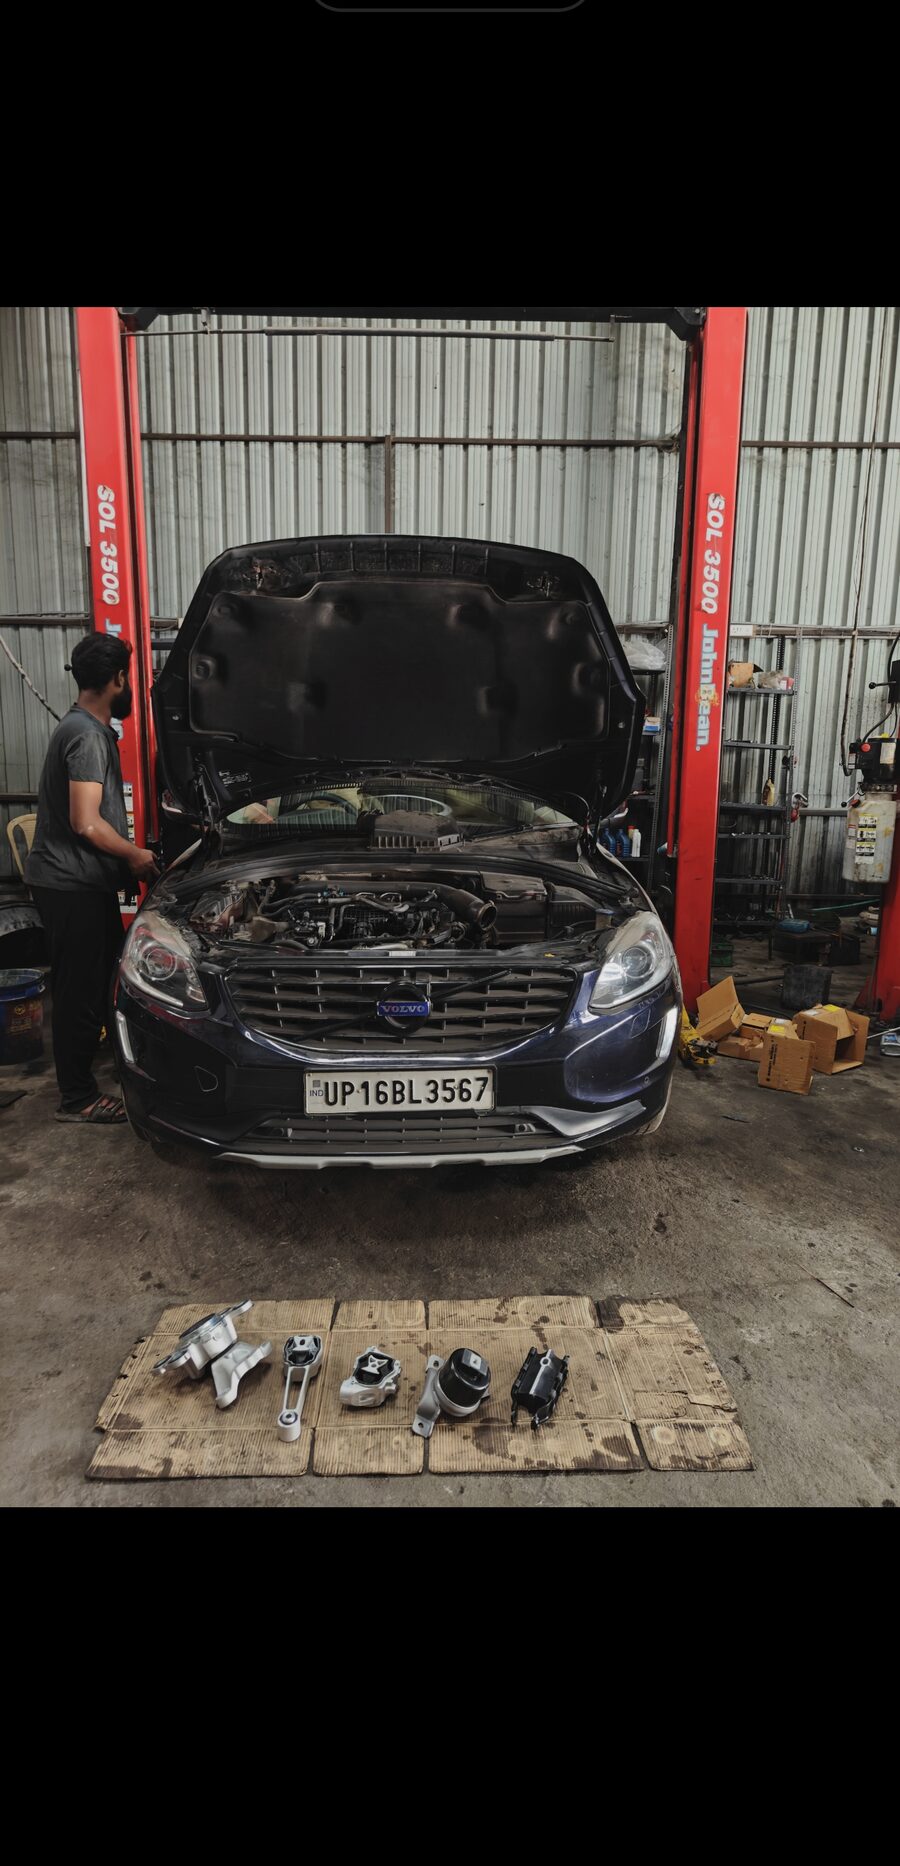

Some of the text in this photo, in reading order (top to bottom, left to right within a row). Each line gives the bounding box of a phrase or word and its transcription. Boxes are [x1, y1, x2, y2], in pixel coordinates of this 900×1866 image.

[97, 485, 117, 534] SOL
[706, 492, 726, 542] SOL
[100, 541, 120, 606] 3500
[701, 549, 721, 614] 3500
[380, 1004, 425, 1013] VOLVO
[309, 1089, 324, 1097] IND
[324, 1076, 489, 1106] UP16BL3567
